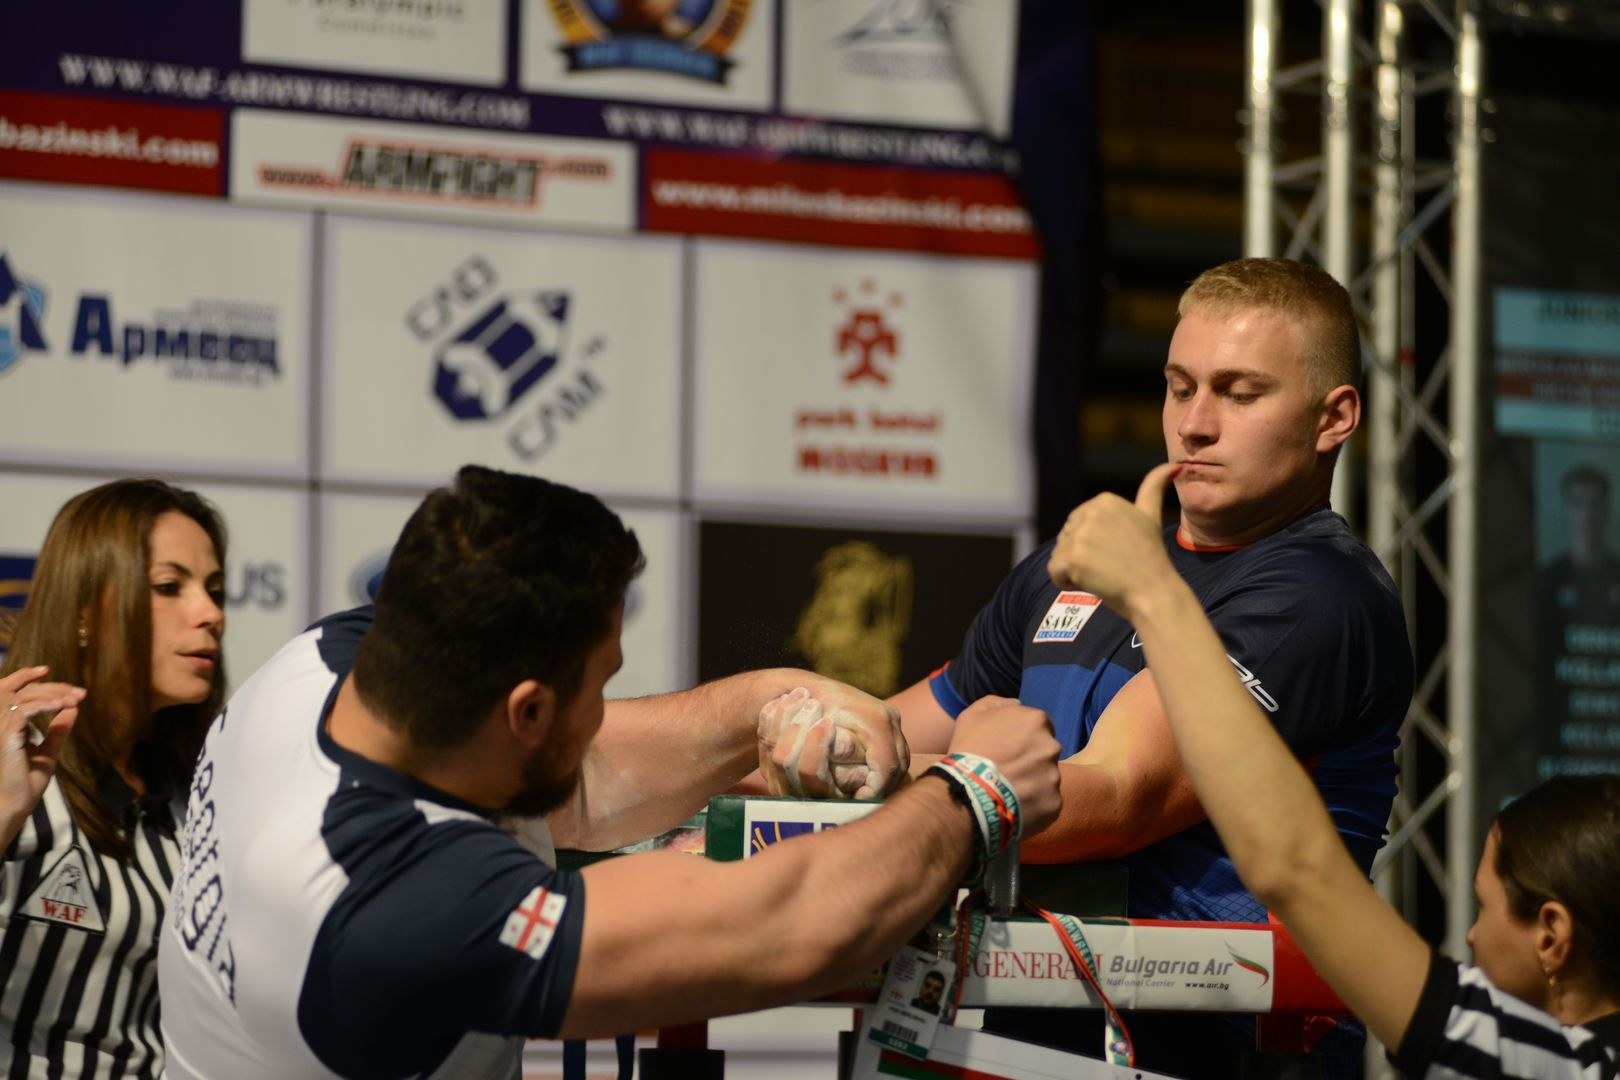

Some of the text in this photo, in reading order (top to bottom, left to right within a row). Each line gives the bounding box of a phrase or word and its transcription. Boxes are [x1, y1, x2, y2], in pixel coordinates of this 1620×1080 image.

[42, 898, 87, 922] WAF
[973, 951, 1233, 981] GENERAI Bulgaria Air
[1106, 976, 1144, 988] National
